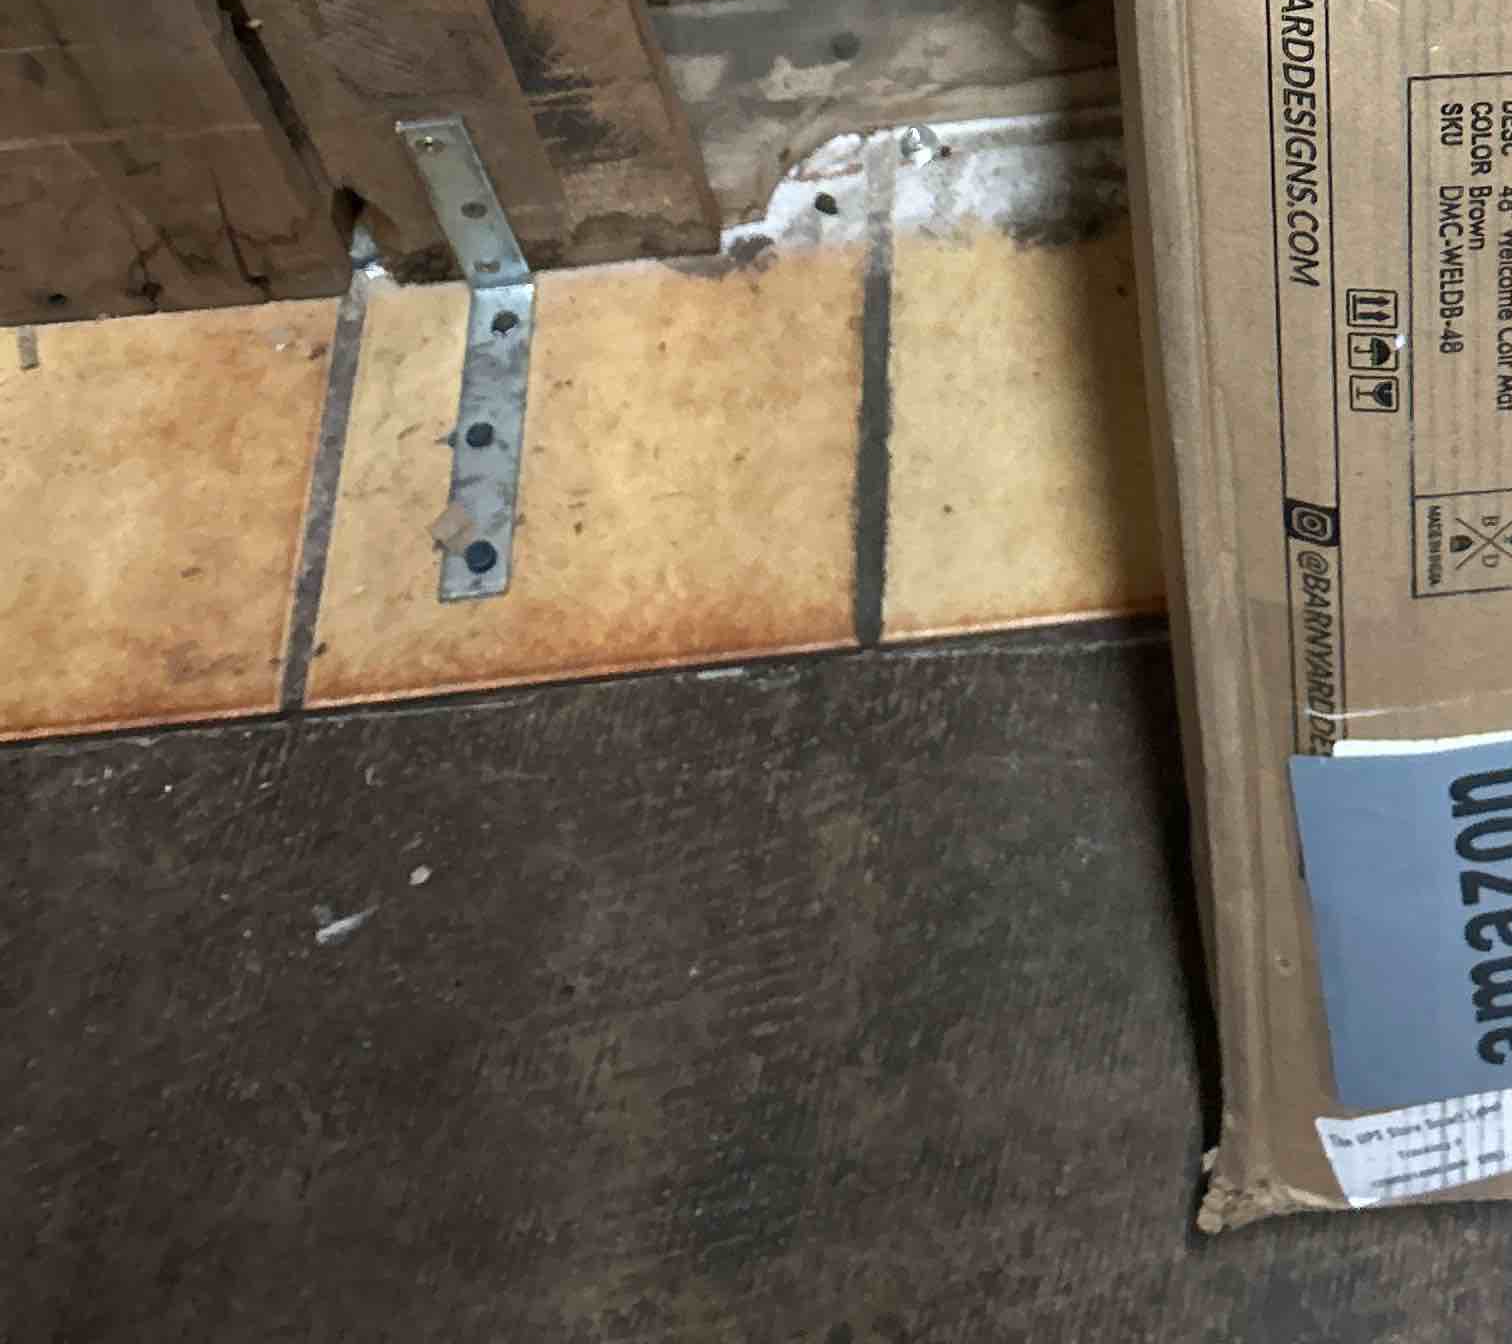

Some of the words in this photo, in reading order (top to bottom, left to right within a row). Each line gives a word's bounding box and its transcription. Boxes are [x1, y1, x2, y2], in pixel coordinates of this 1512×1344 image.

[1440, 102, 1464, 147] SKU
[1470, 101, 1493, 176] COLOR
[1468, 184, 1491, 251] Brown
[1438, 184, 1465, 355] DMC-WELDB-48
